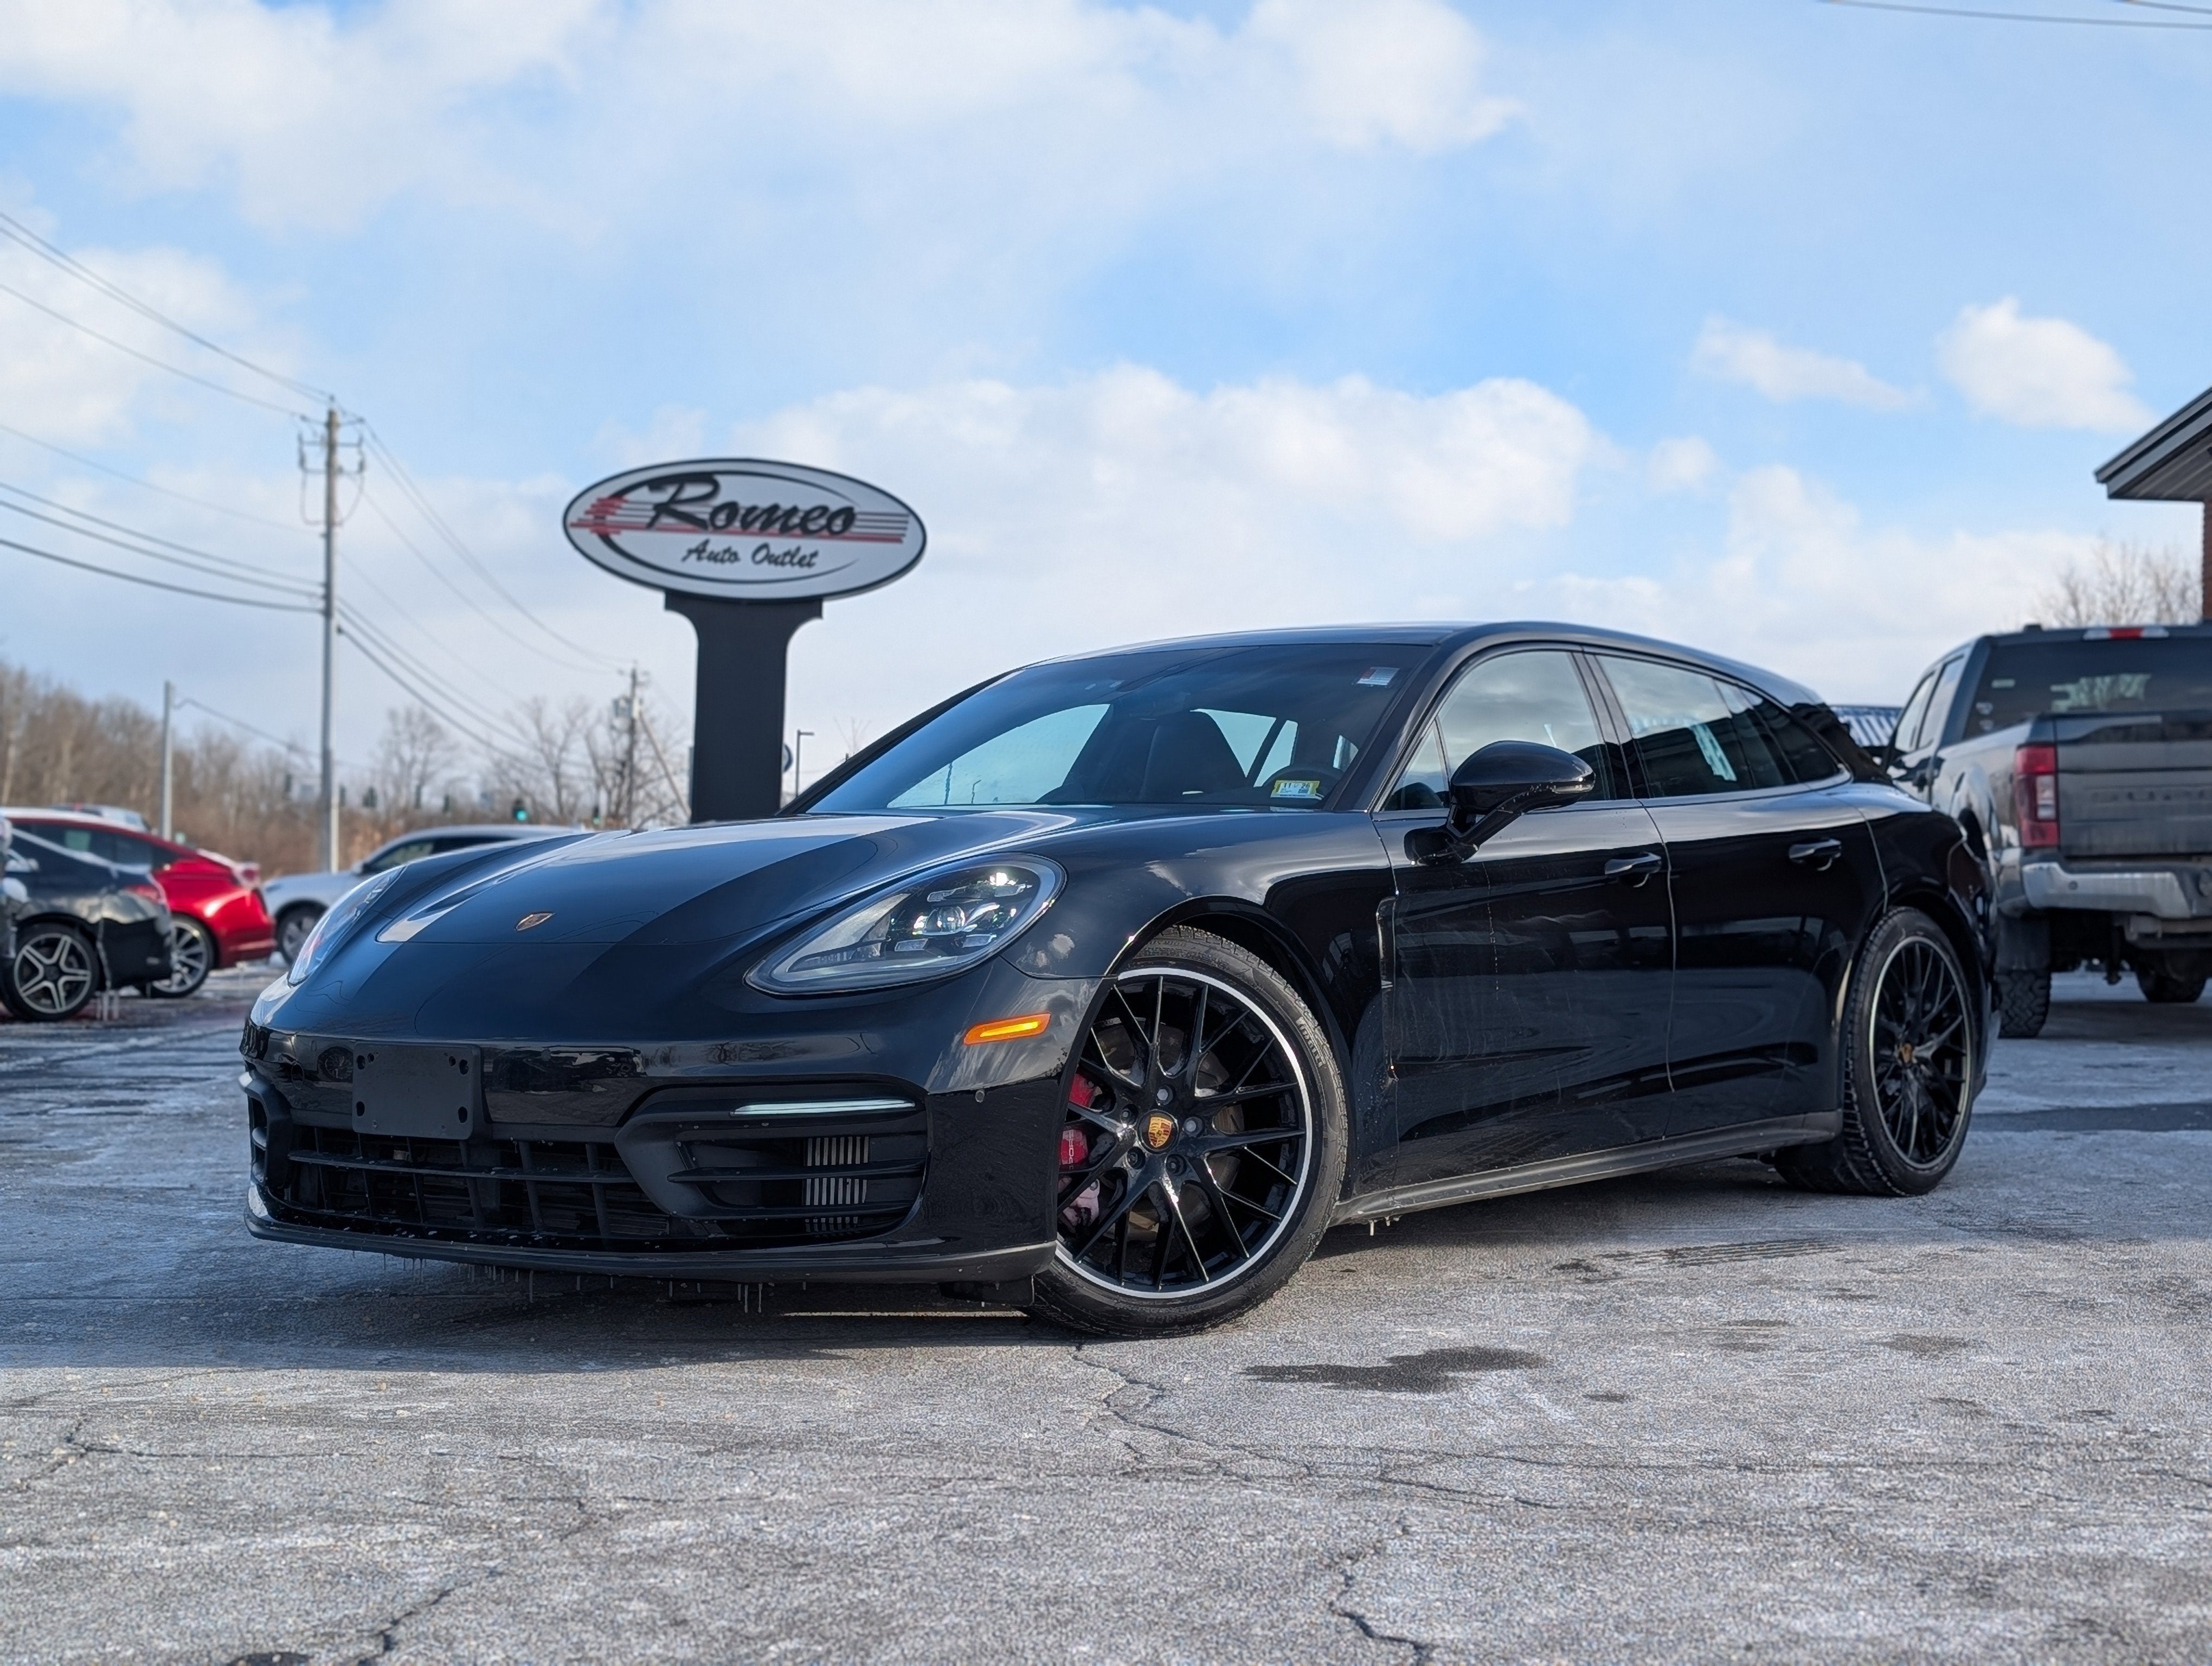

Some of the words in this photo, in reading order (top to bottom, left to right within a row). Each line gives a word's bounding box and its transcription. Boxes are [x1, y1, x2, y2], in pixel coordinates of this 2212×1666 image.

[646, 473, 856, 535] Romeo
[681, 539, 741, 564] Auto
[751, 542, 819, 569] Outlet
